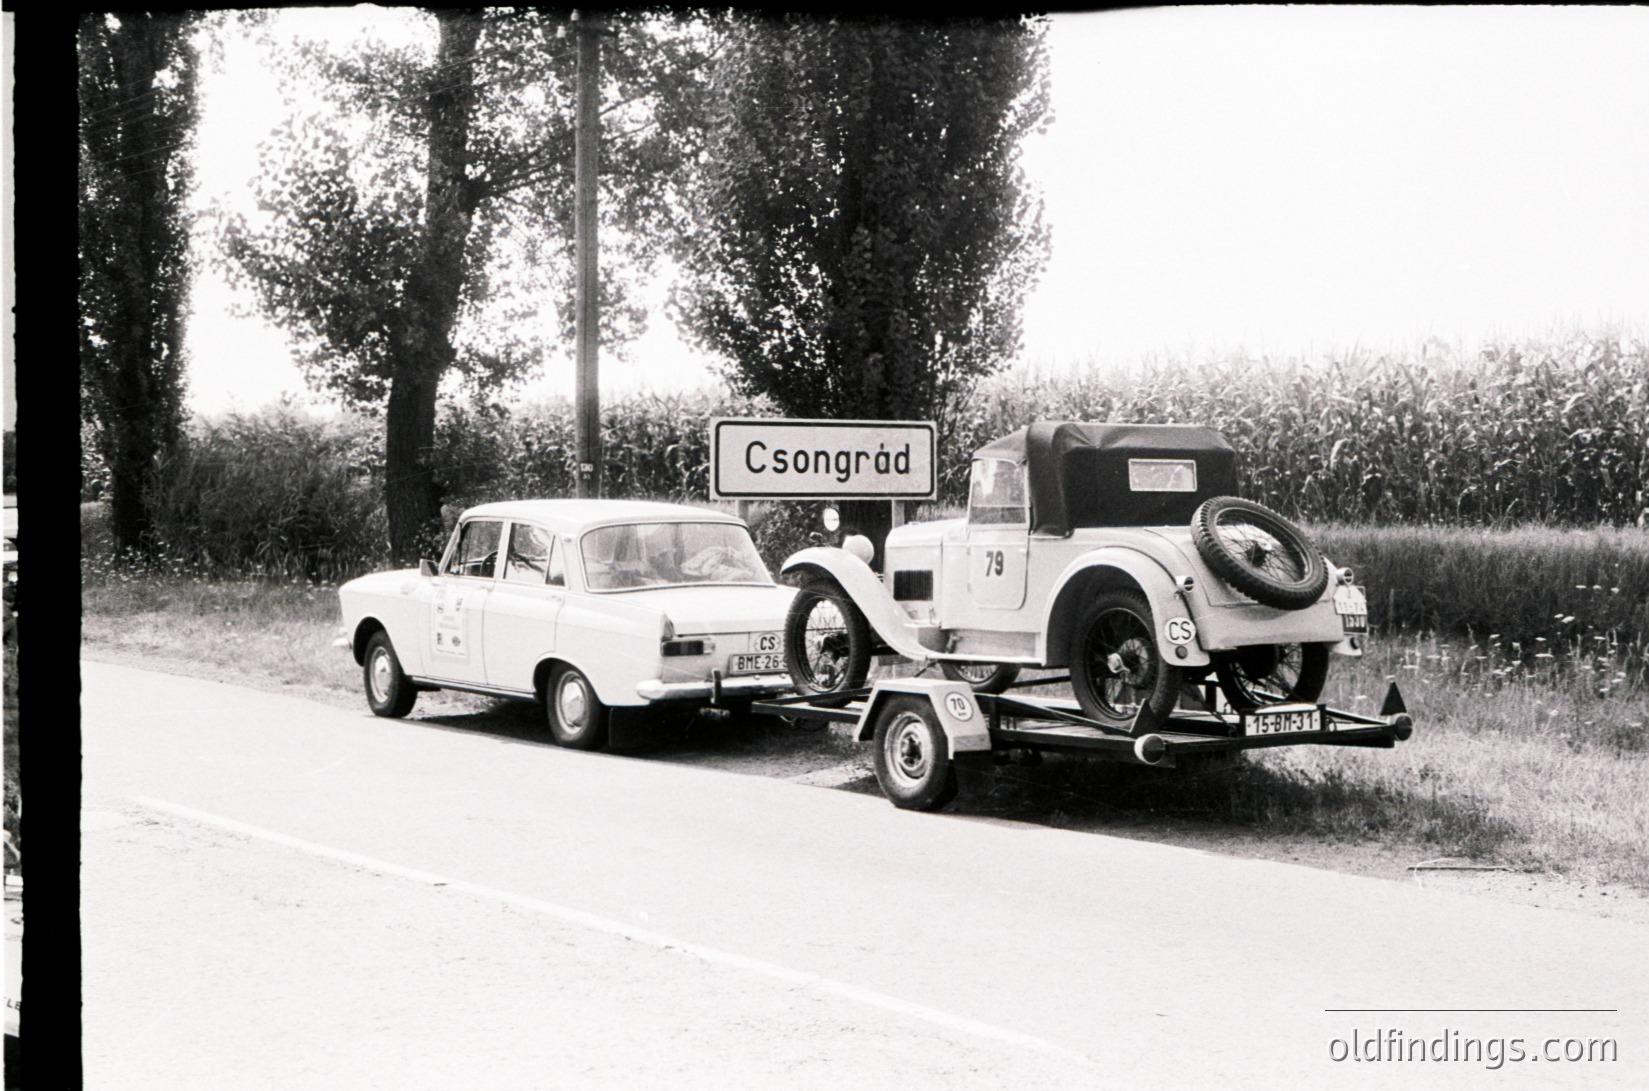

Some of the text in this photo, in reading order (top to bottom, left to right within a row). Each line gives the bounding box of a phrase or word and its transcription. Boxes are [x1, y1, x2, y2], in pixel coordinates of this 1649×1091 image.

[745, 440, 910, 483] Csongrád
[985, 549, 1004, 577] 79
[1168, 620, 1192, 641] CS
[760, 636, 776, 651] CS
[950, 697, 966, 711] 70
